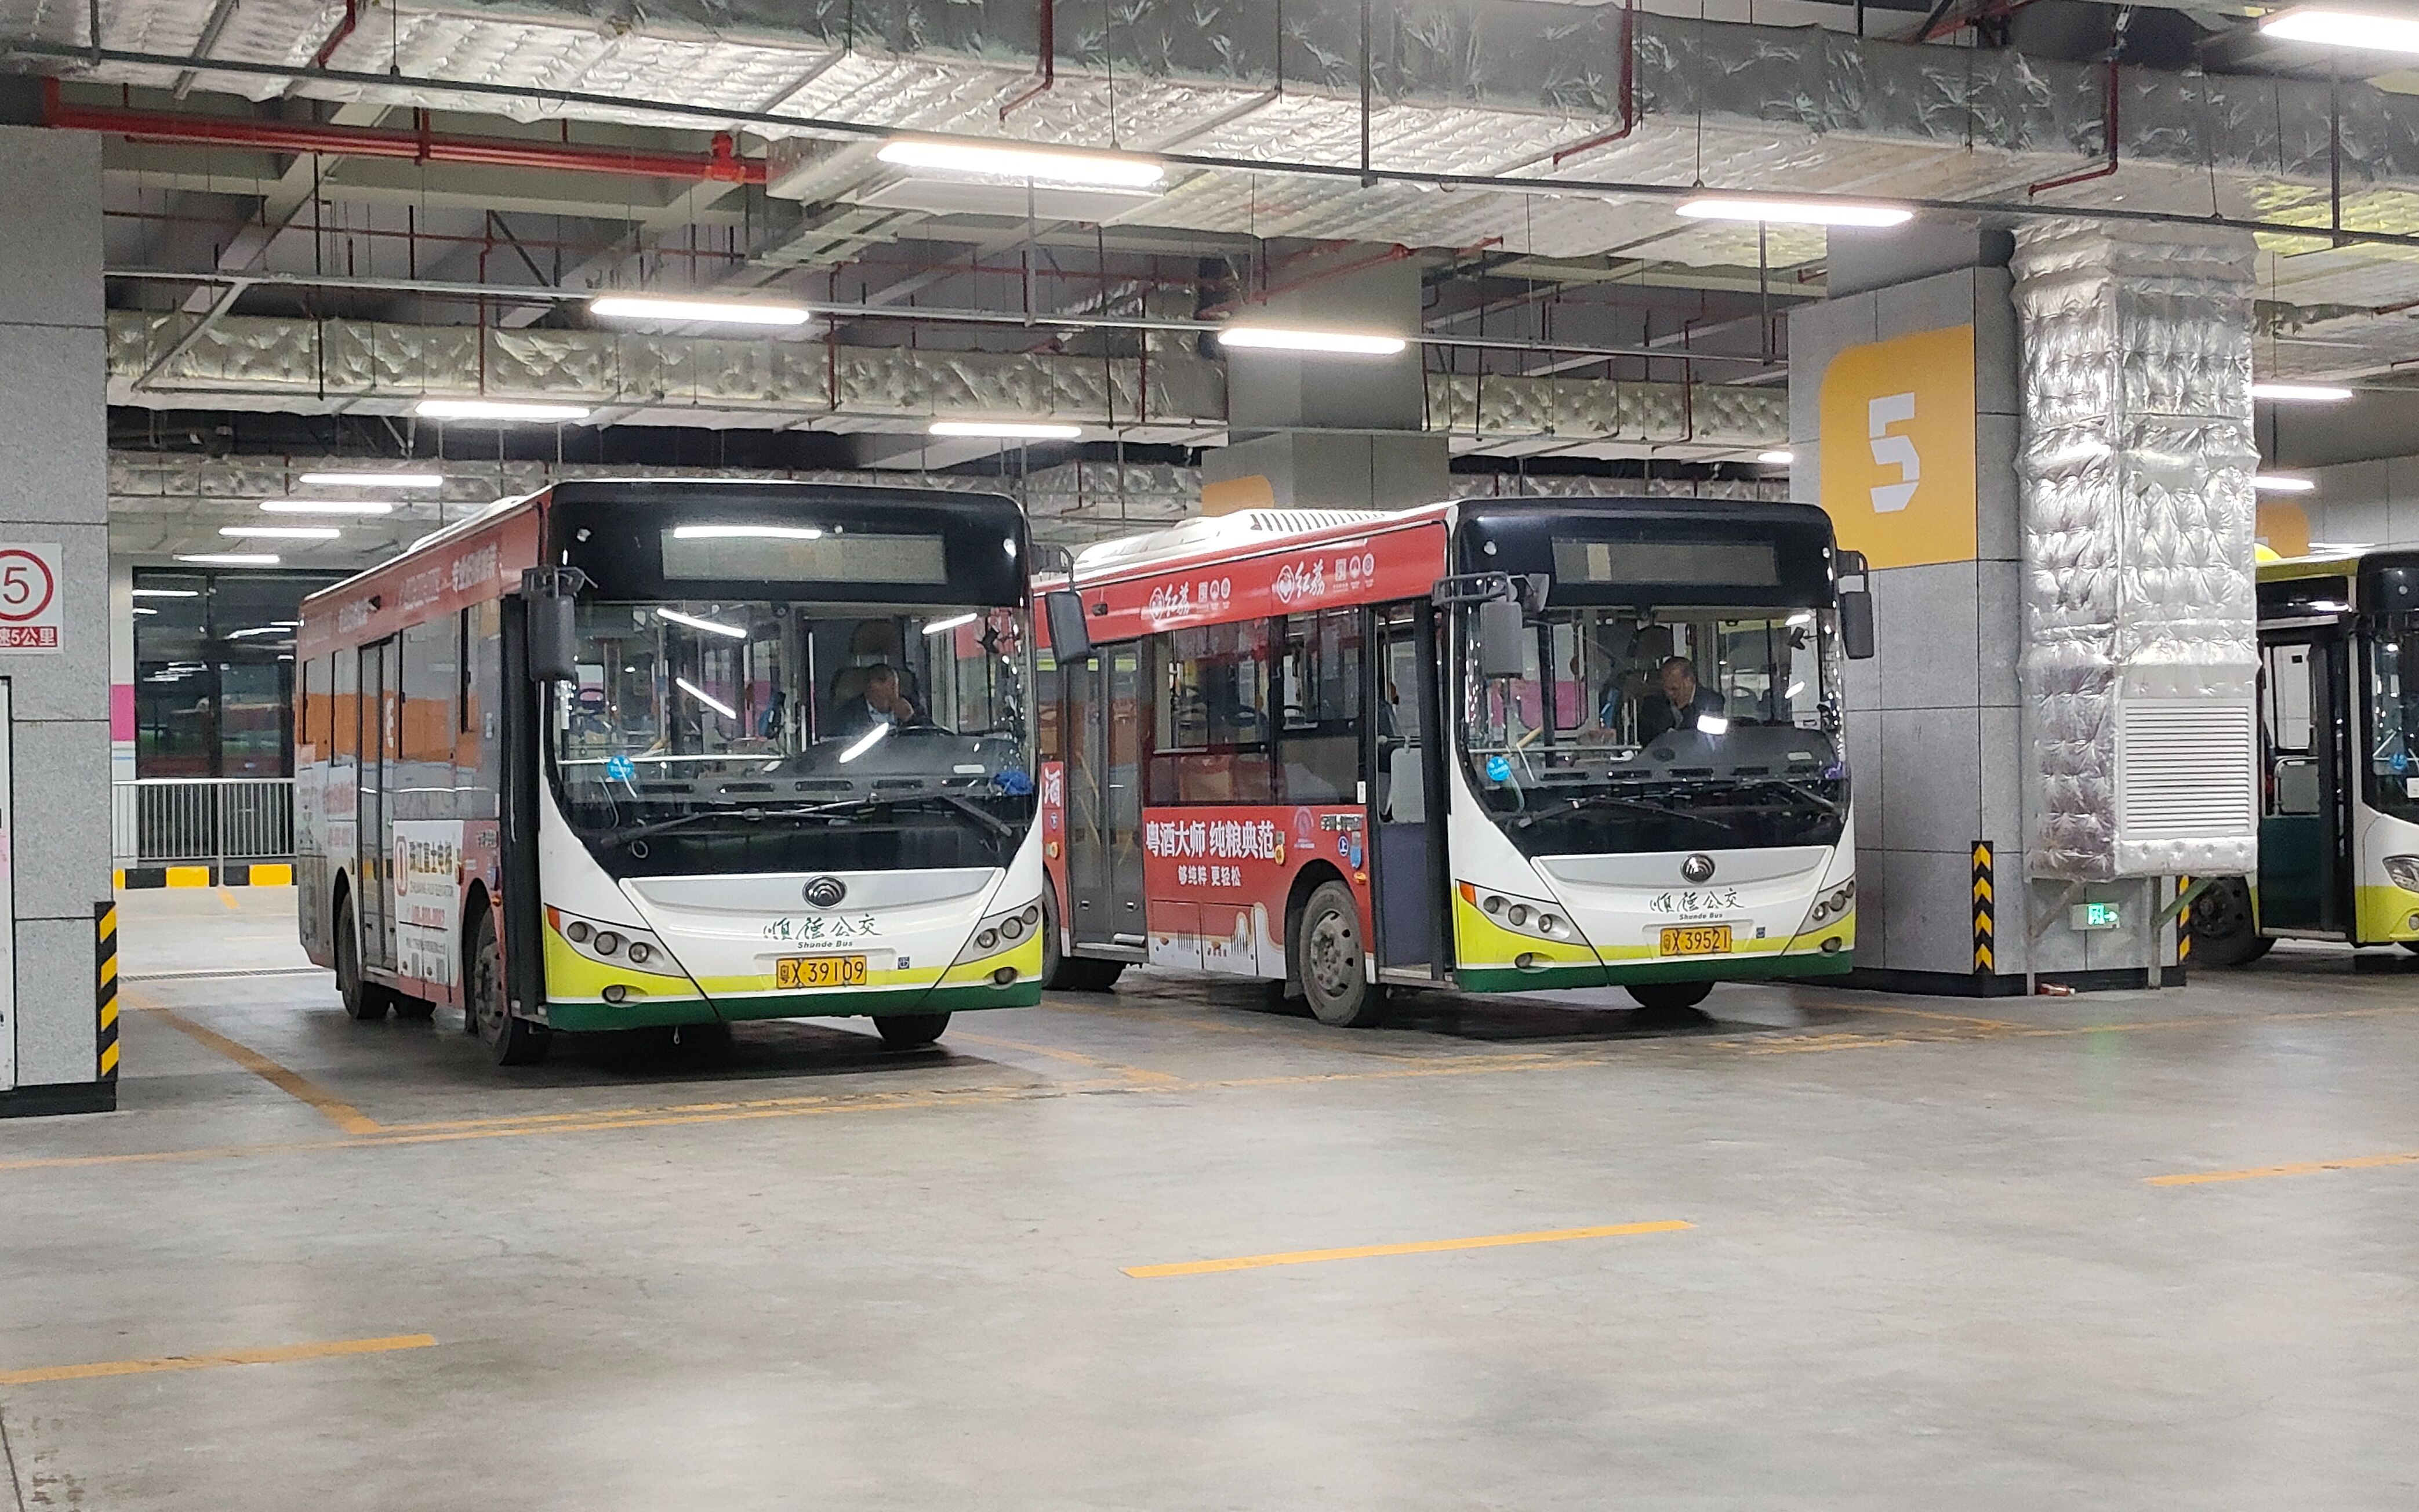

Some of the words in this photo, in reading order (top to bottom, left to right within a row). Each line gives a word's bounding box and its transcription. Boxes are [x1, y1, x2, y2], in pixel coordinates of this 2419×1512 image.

[1869, 392, 1920, 514] 5
[3, 566, 30, 604] 5
[1146, 820, 1206, 858] 粤酒大师
[1210, 820, 1274, 859] 纯粮典范
